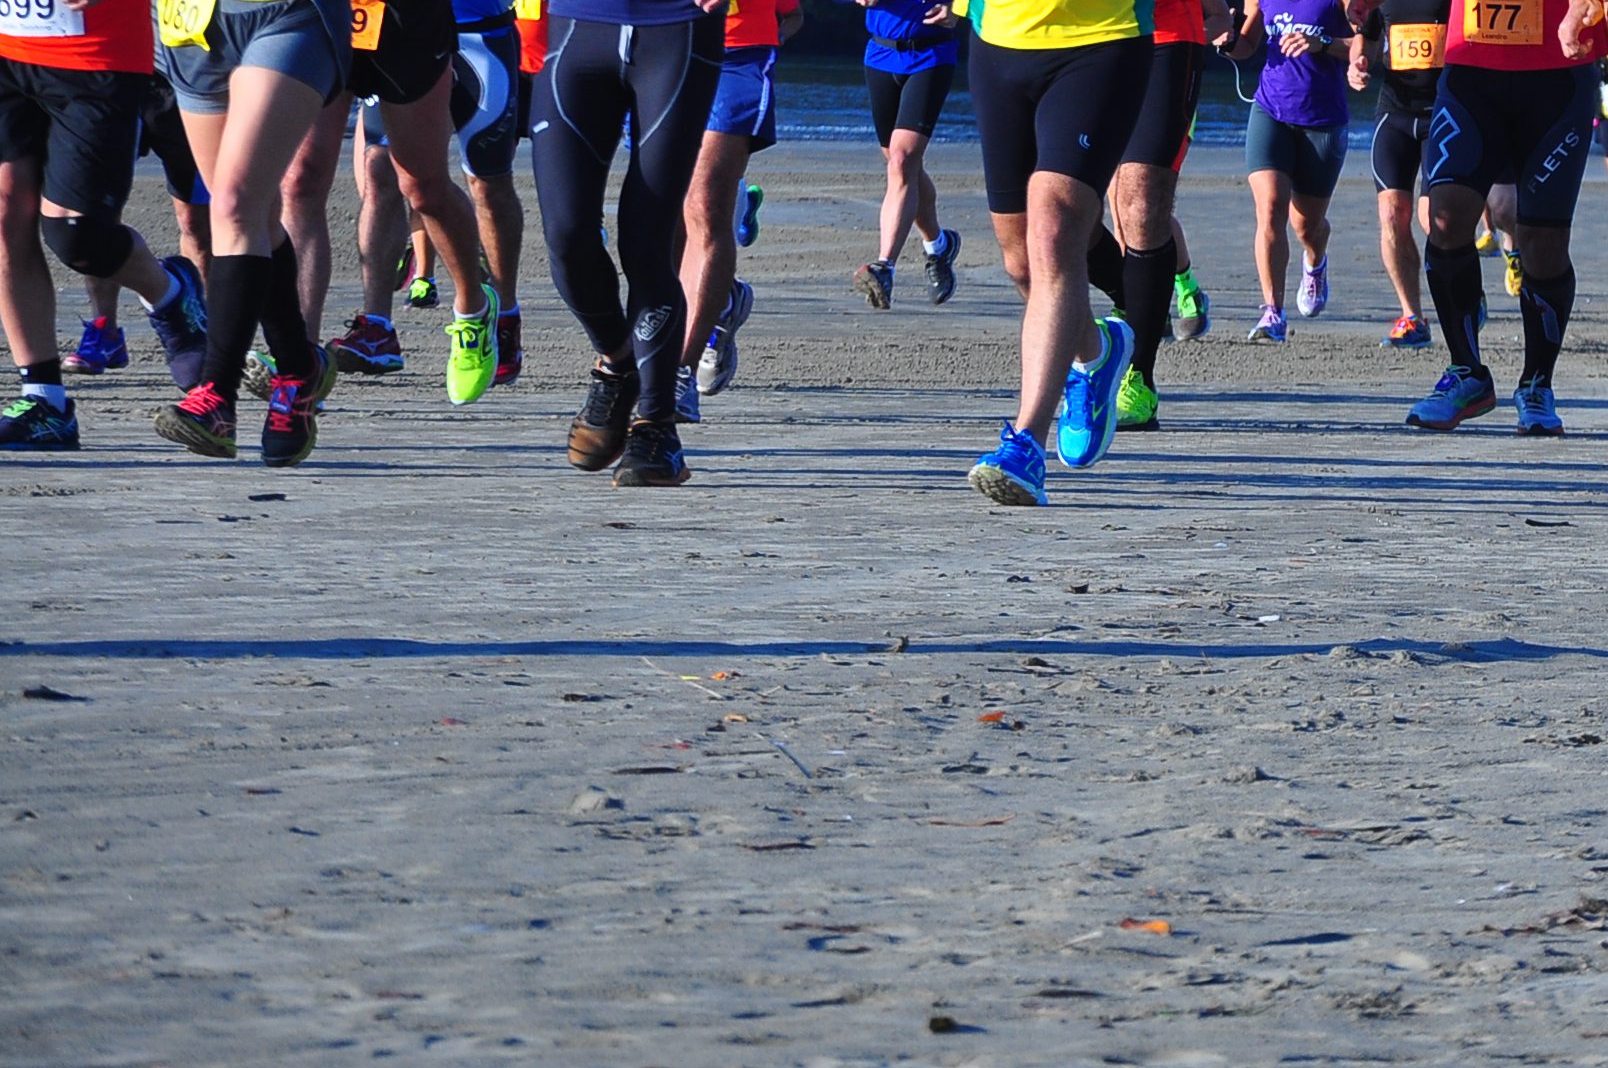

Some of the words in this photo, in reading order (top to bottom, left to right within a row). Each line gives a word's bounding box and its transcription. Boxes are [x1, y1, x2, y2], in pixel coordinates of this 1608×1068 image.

[1472, 2, 1522, 31] 177
[1396, 39, 1433, 59] 159
[1527, 131, 1581, 194] FLETS
